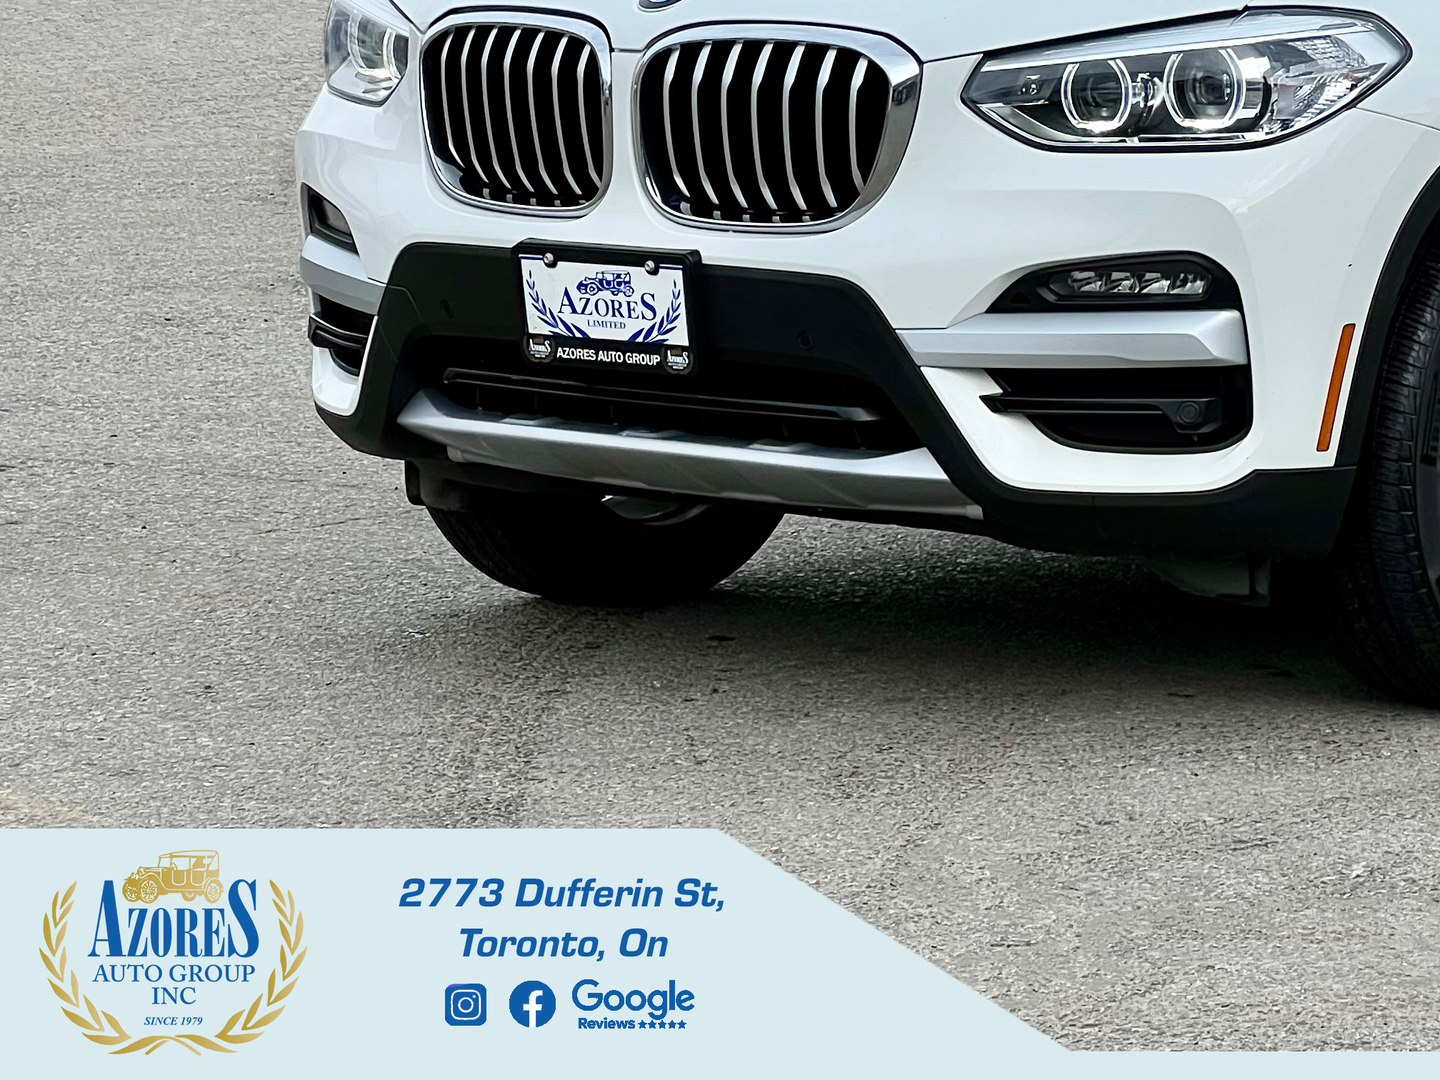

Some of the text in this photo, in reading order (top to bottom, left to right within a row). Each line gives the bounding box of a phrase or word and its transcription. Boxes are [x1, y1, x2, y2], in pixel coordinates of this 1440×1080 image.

[557, 286, 657, 321] AZORES
[587, 319, 626, 330] LIMITED
[556, 346, 596, 361] AZORES
[598, 350, 624, 363] AUTO
[625, 352, 661, 366] GROUP
